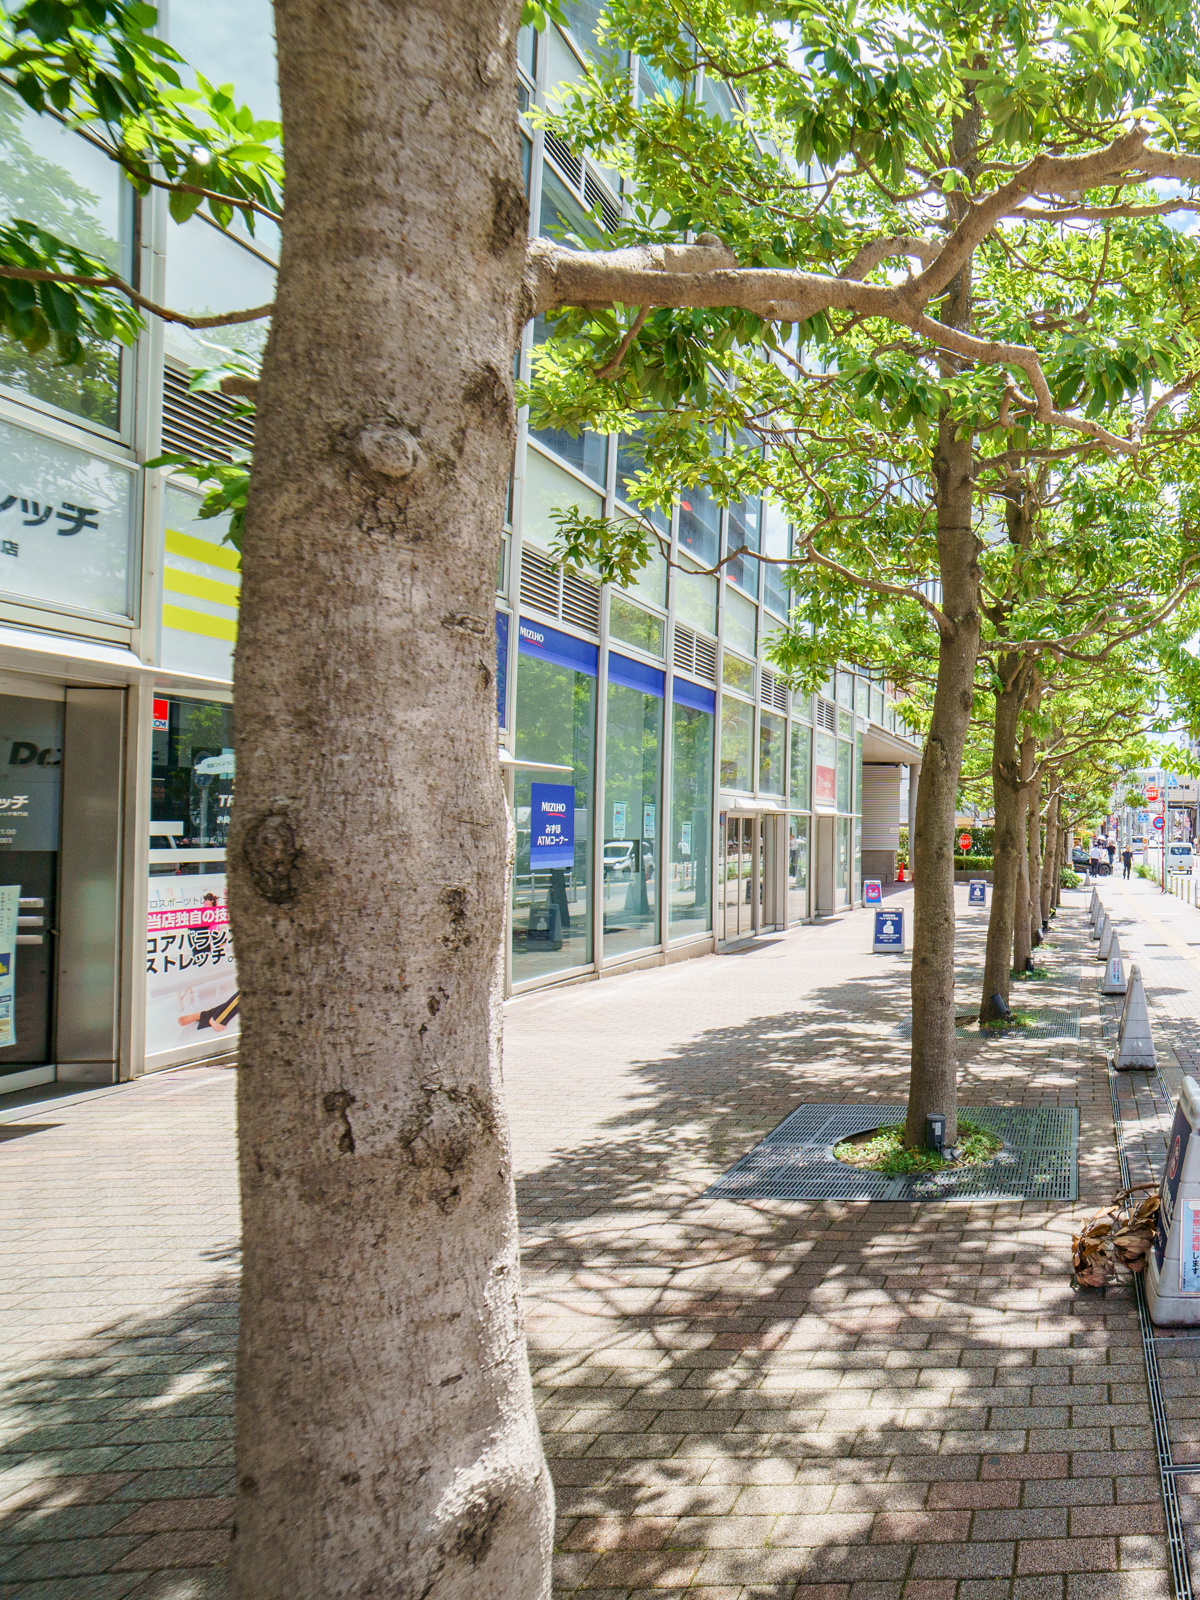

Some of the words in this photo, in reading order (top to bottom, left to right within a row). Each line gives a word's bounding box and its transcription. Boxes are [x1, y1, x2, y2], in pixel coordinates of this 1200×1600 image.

[520, 626, 544, 643] MIZUHO
[541, 802, 566, 812] MIZUHO
[545, 824, 562, 834] みずほ
[537, 835, 569, 846] ATMコーナー
[148, 906, 230, 929] 当店独自の技
[1192, 1210, 1200, 1279] 警察に通報します。
